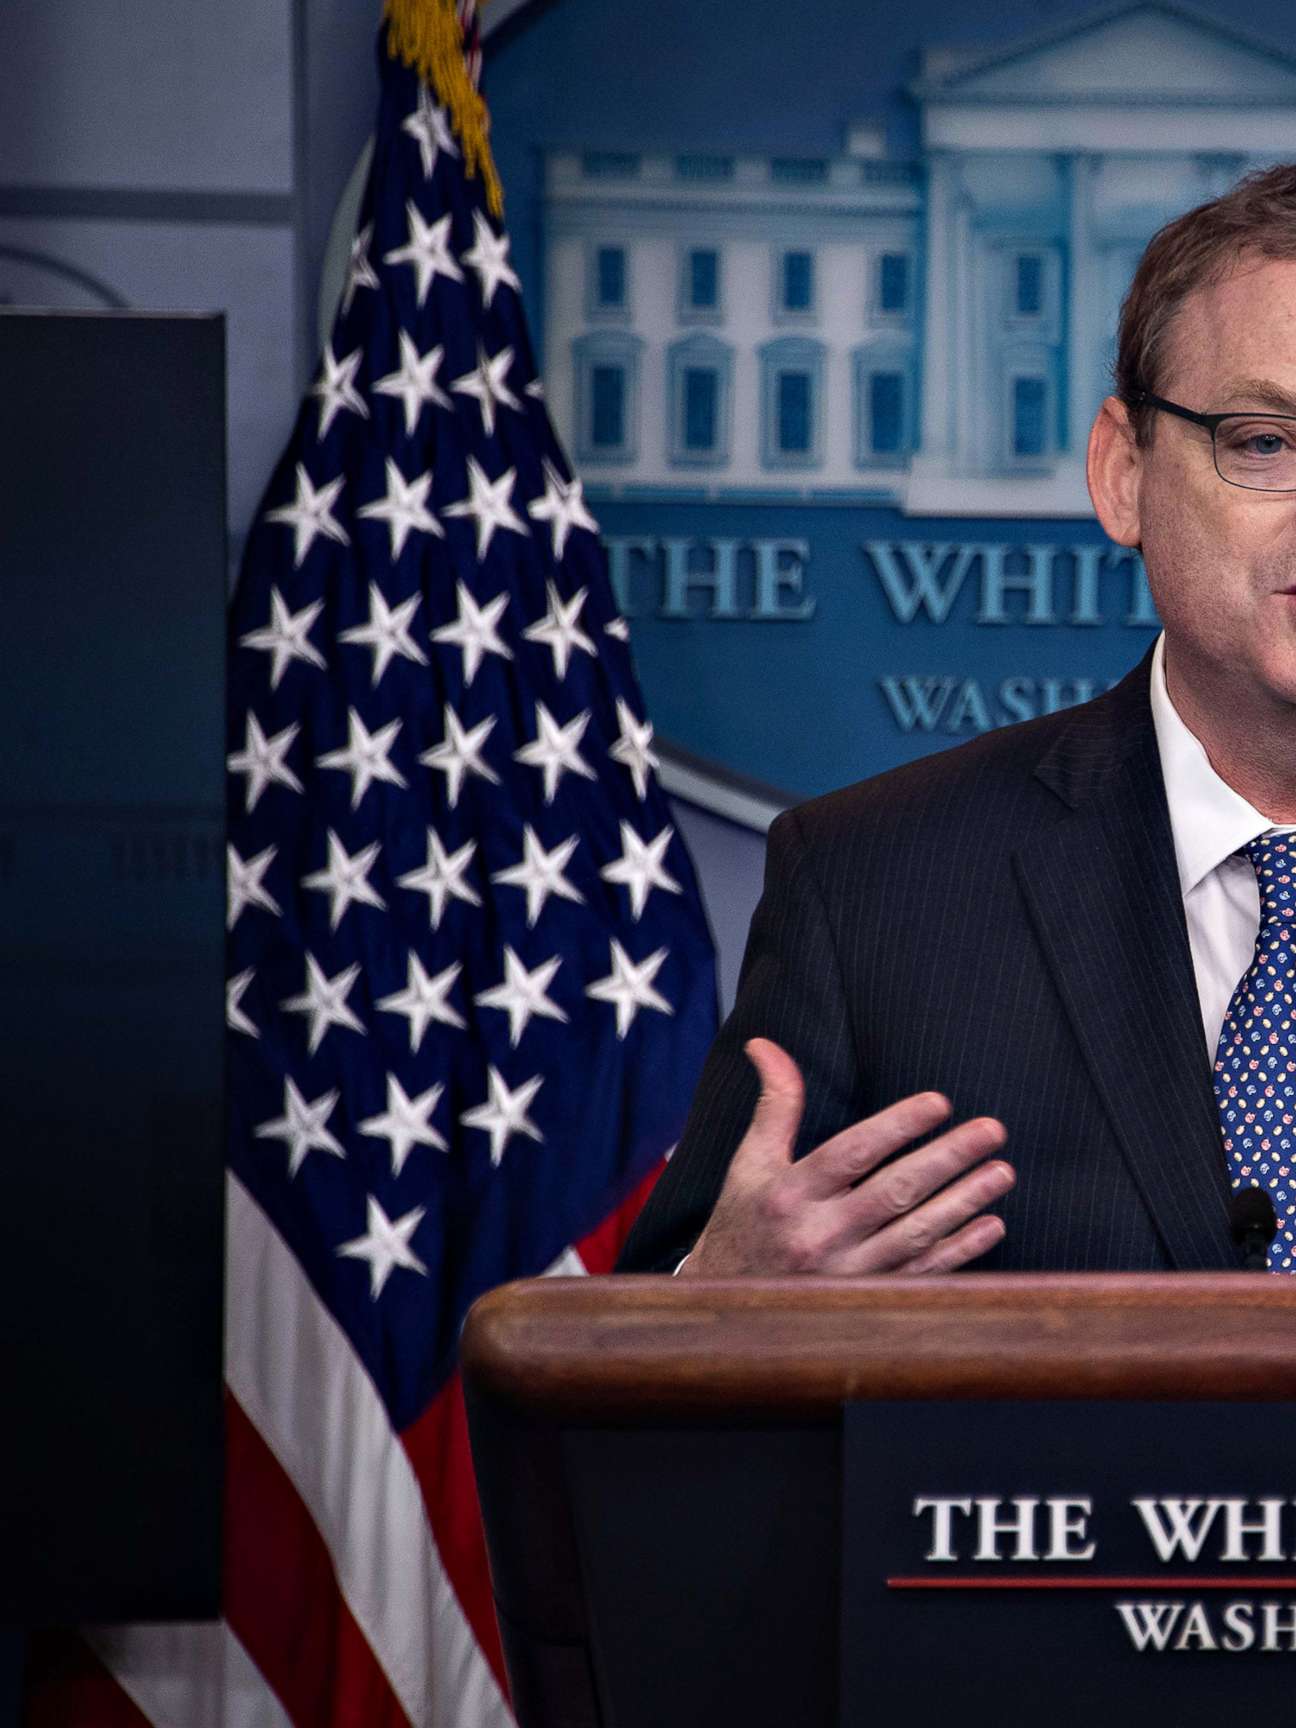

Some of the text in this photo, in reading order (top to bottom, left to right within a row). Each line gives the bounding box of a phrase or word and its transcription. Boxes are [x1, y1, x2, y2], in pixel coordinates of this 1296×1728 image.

[600, 534, 817, 621] THE
[863, 539, 1162, 626] WHIT
[879, 674, 1102, 734] WASH
[913, 1496, 1096, 1561] THE
